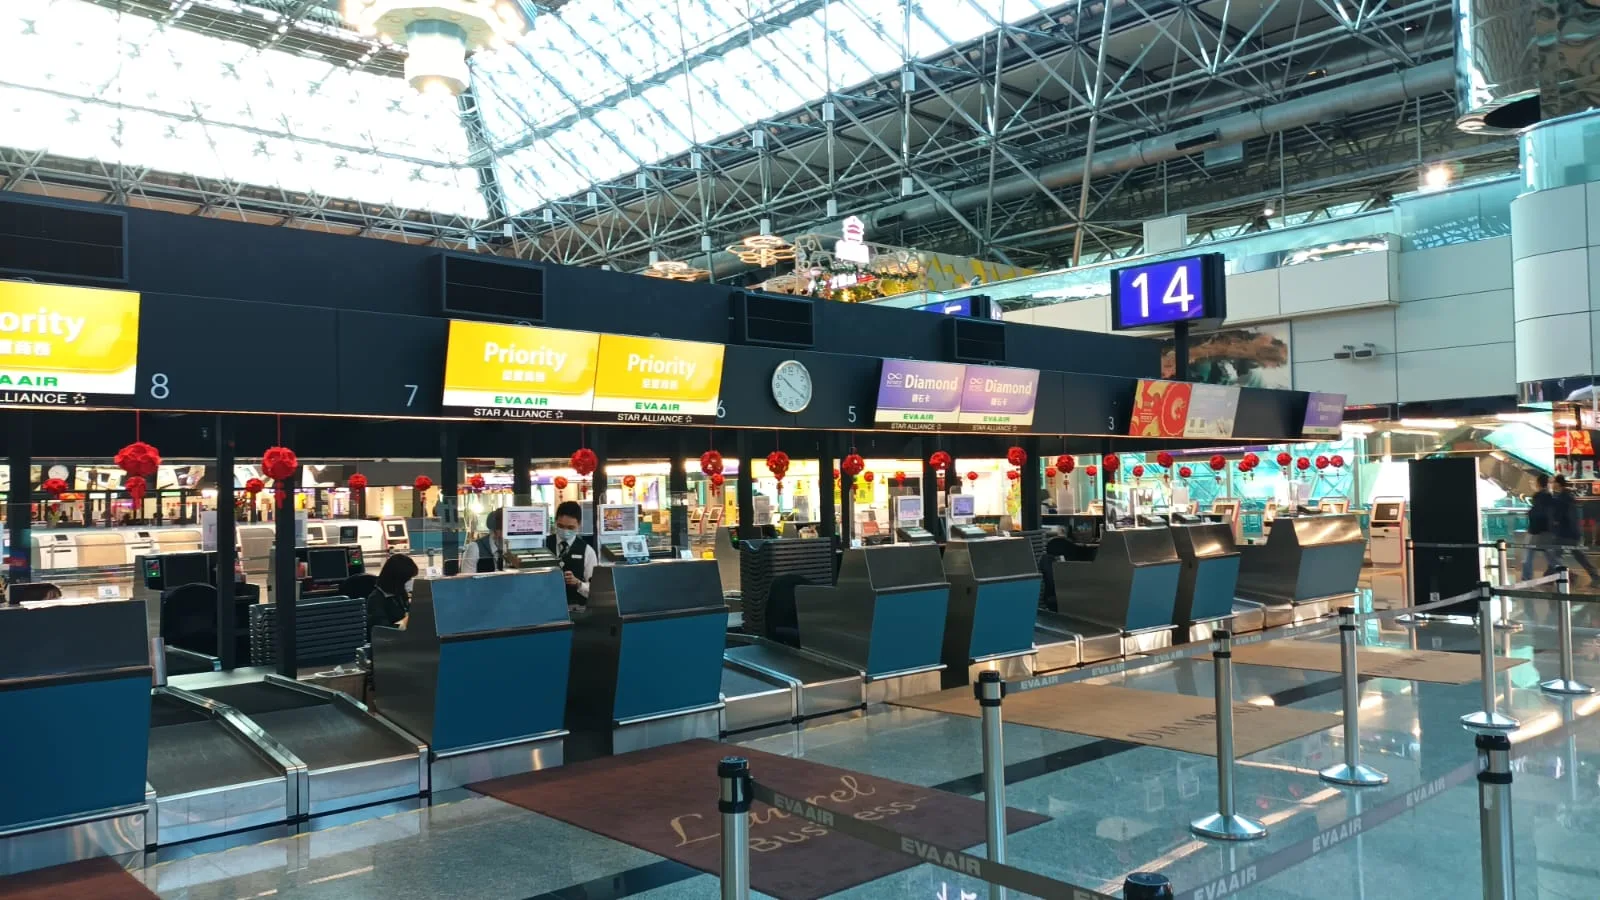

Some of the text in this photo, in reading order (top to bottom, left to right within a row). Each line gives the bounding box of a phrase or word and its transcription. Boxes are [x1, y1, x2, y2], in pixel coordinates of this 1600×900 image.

[1131, 265, 1195, 318] 14
[484, 341, 568, 372] Priority
[627, 353, 697, 381] Priority
[151, 373, 170, 400] 8
[904, 374, 959, 391] Diamond
[984, 378, 1033, 395] Diamond
[0, 392, 68, 404] LIANCE
[404, 384, 418, 407] 7
[473, 408, 553, 419] STAR ALLIANCE
[617, 413, 683, 423] STAR ALLIANCE
[716, 400, 726, 419] 6
[848, 405, 857, 423] 5
[1108, 416, 1115, 431] 3
[749, 800, 917, 852] Busess
